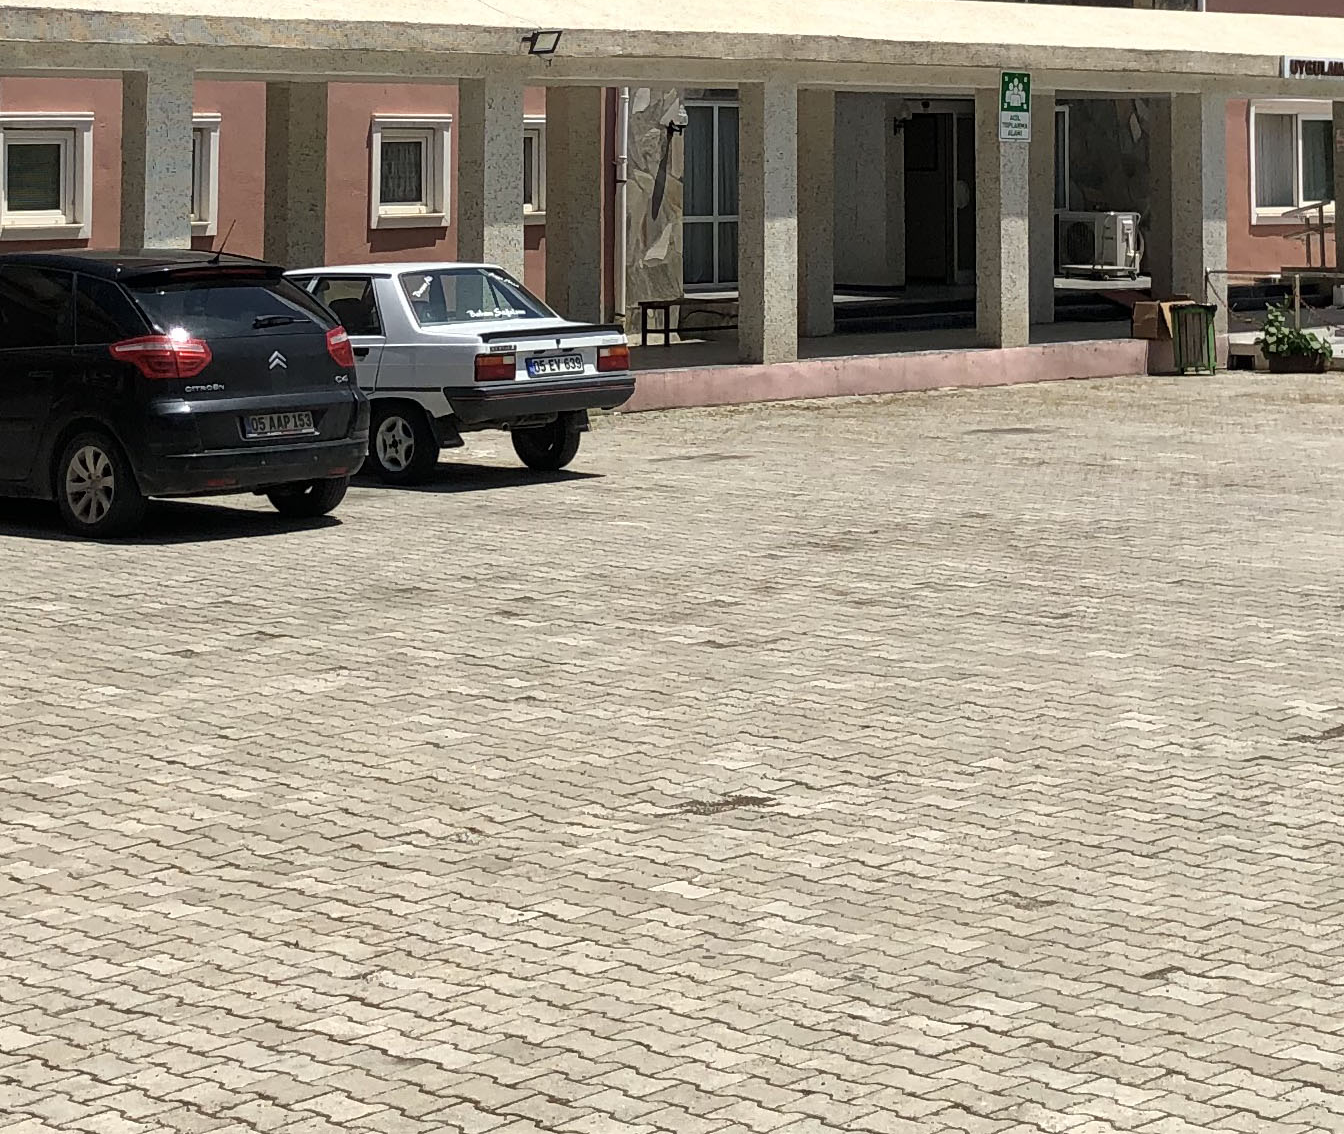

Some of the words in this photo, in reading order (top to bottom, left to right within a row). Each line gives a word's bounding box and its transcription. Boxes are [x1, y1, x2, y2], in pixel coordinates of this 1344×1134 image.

[533, 360, 547, 373] 05
[548, 358, 561, 372] EV
[563, 356, 582, 371] 639
[335, 374, 349, 384] C4
[251, 416, 266, 432] 05
[269, 414, 292, 432] AAP
[292, 412, 312, 428] 153
